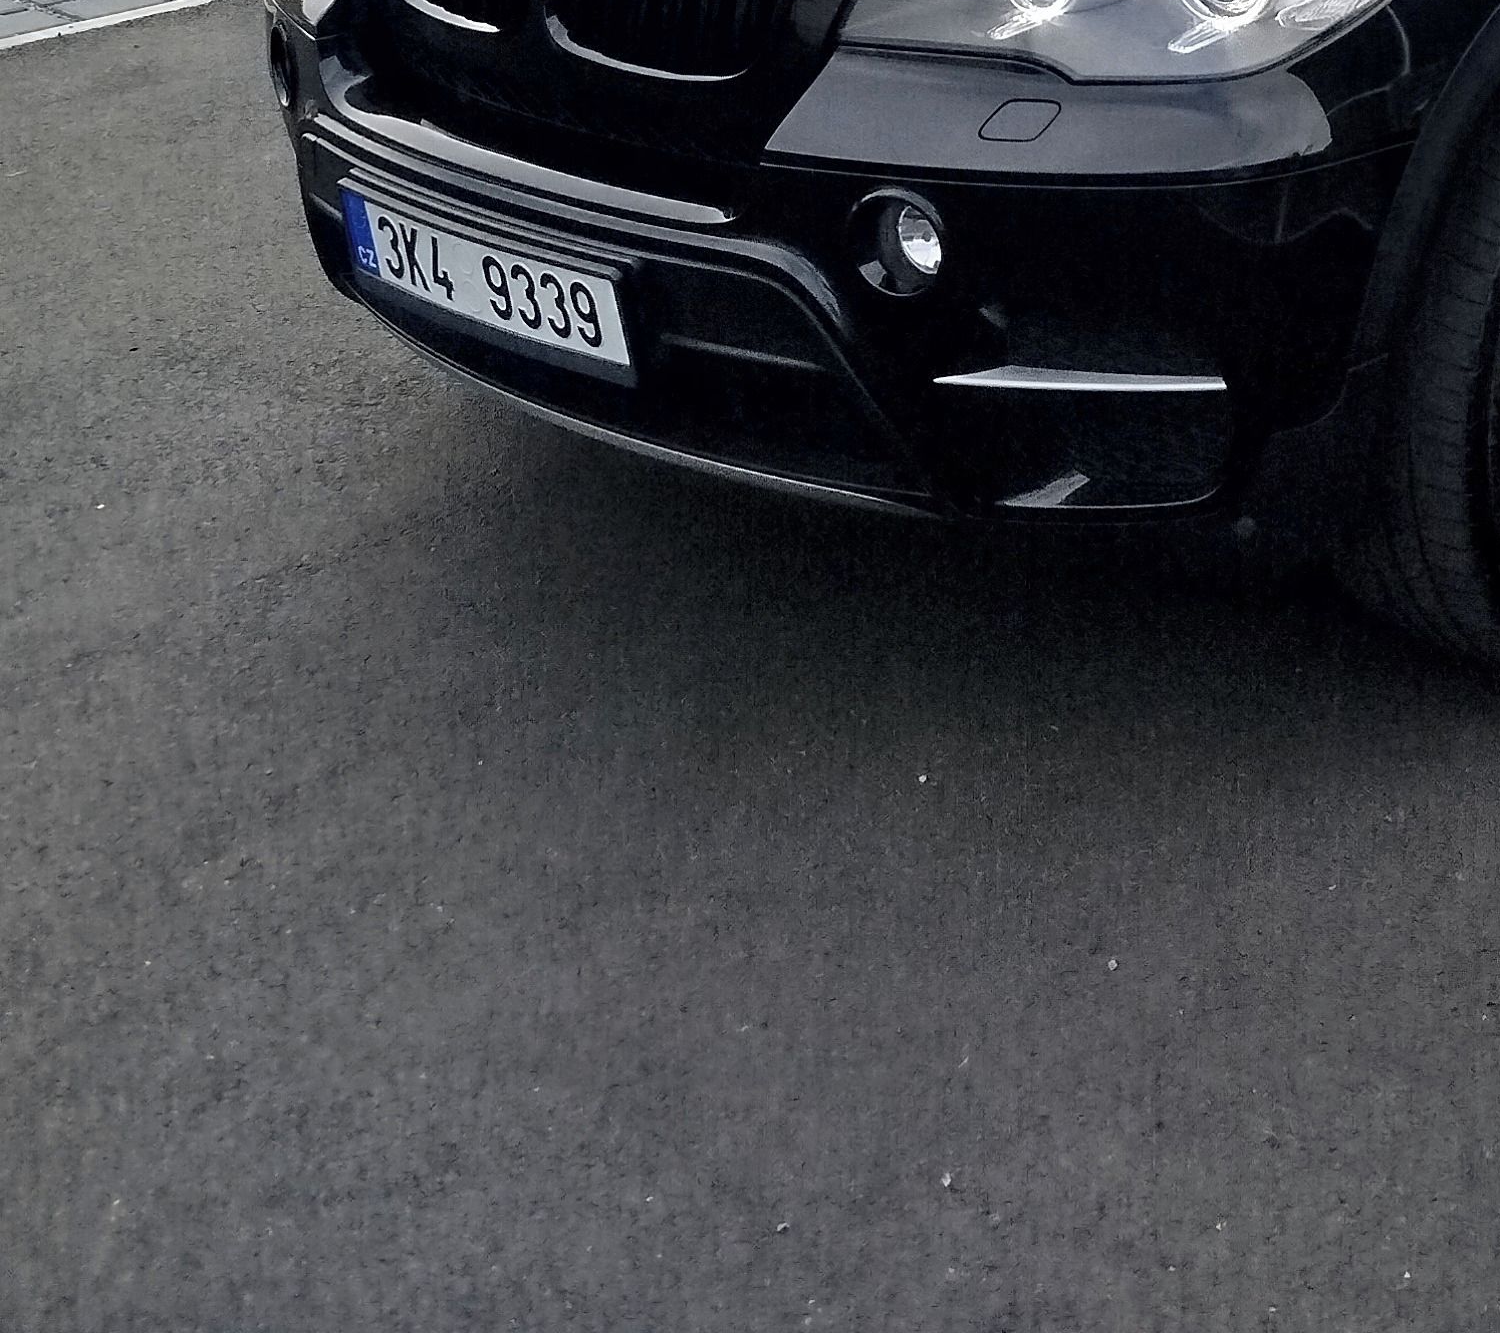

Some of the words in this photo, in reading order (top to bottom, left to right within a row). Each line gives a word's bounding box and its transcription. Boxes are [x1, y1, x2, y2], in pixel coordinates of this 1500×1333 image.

[358, 245, 377, 268] CZ
[378, 216, 455, 302] 3K4
[482, 255, 603, 348] 9339
